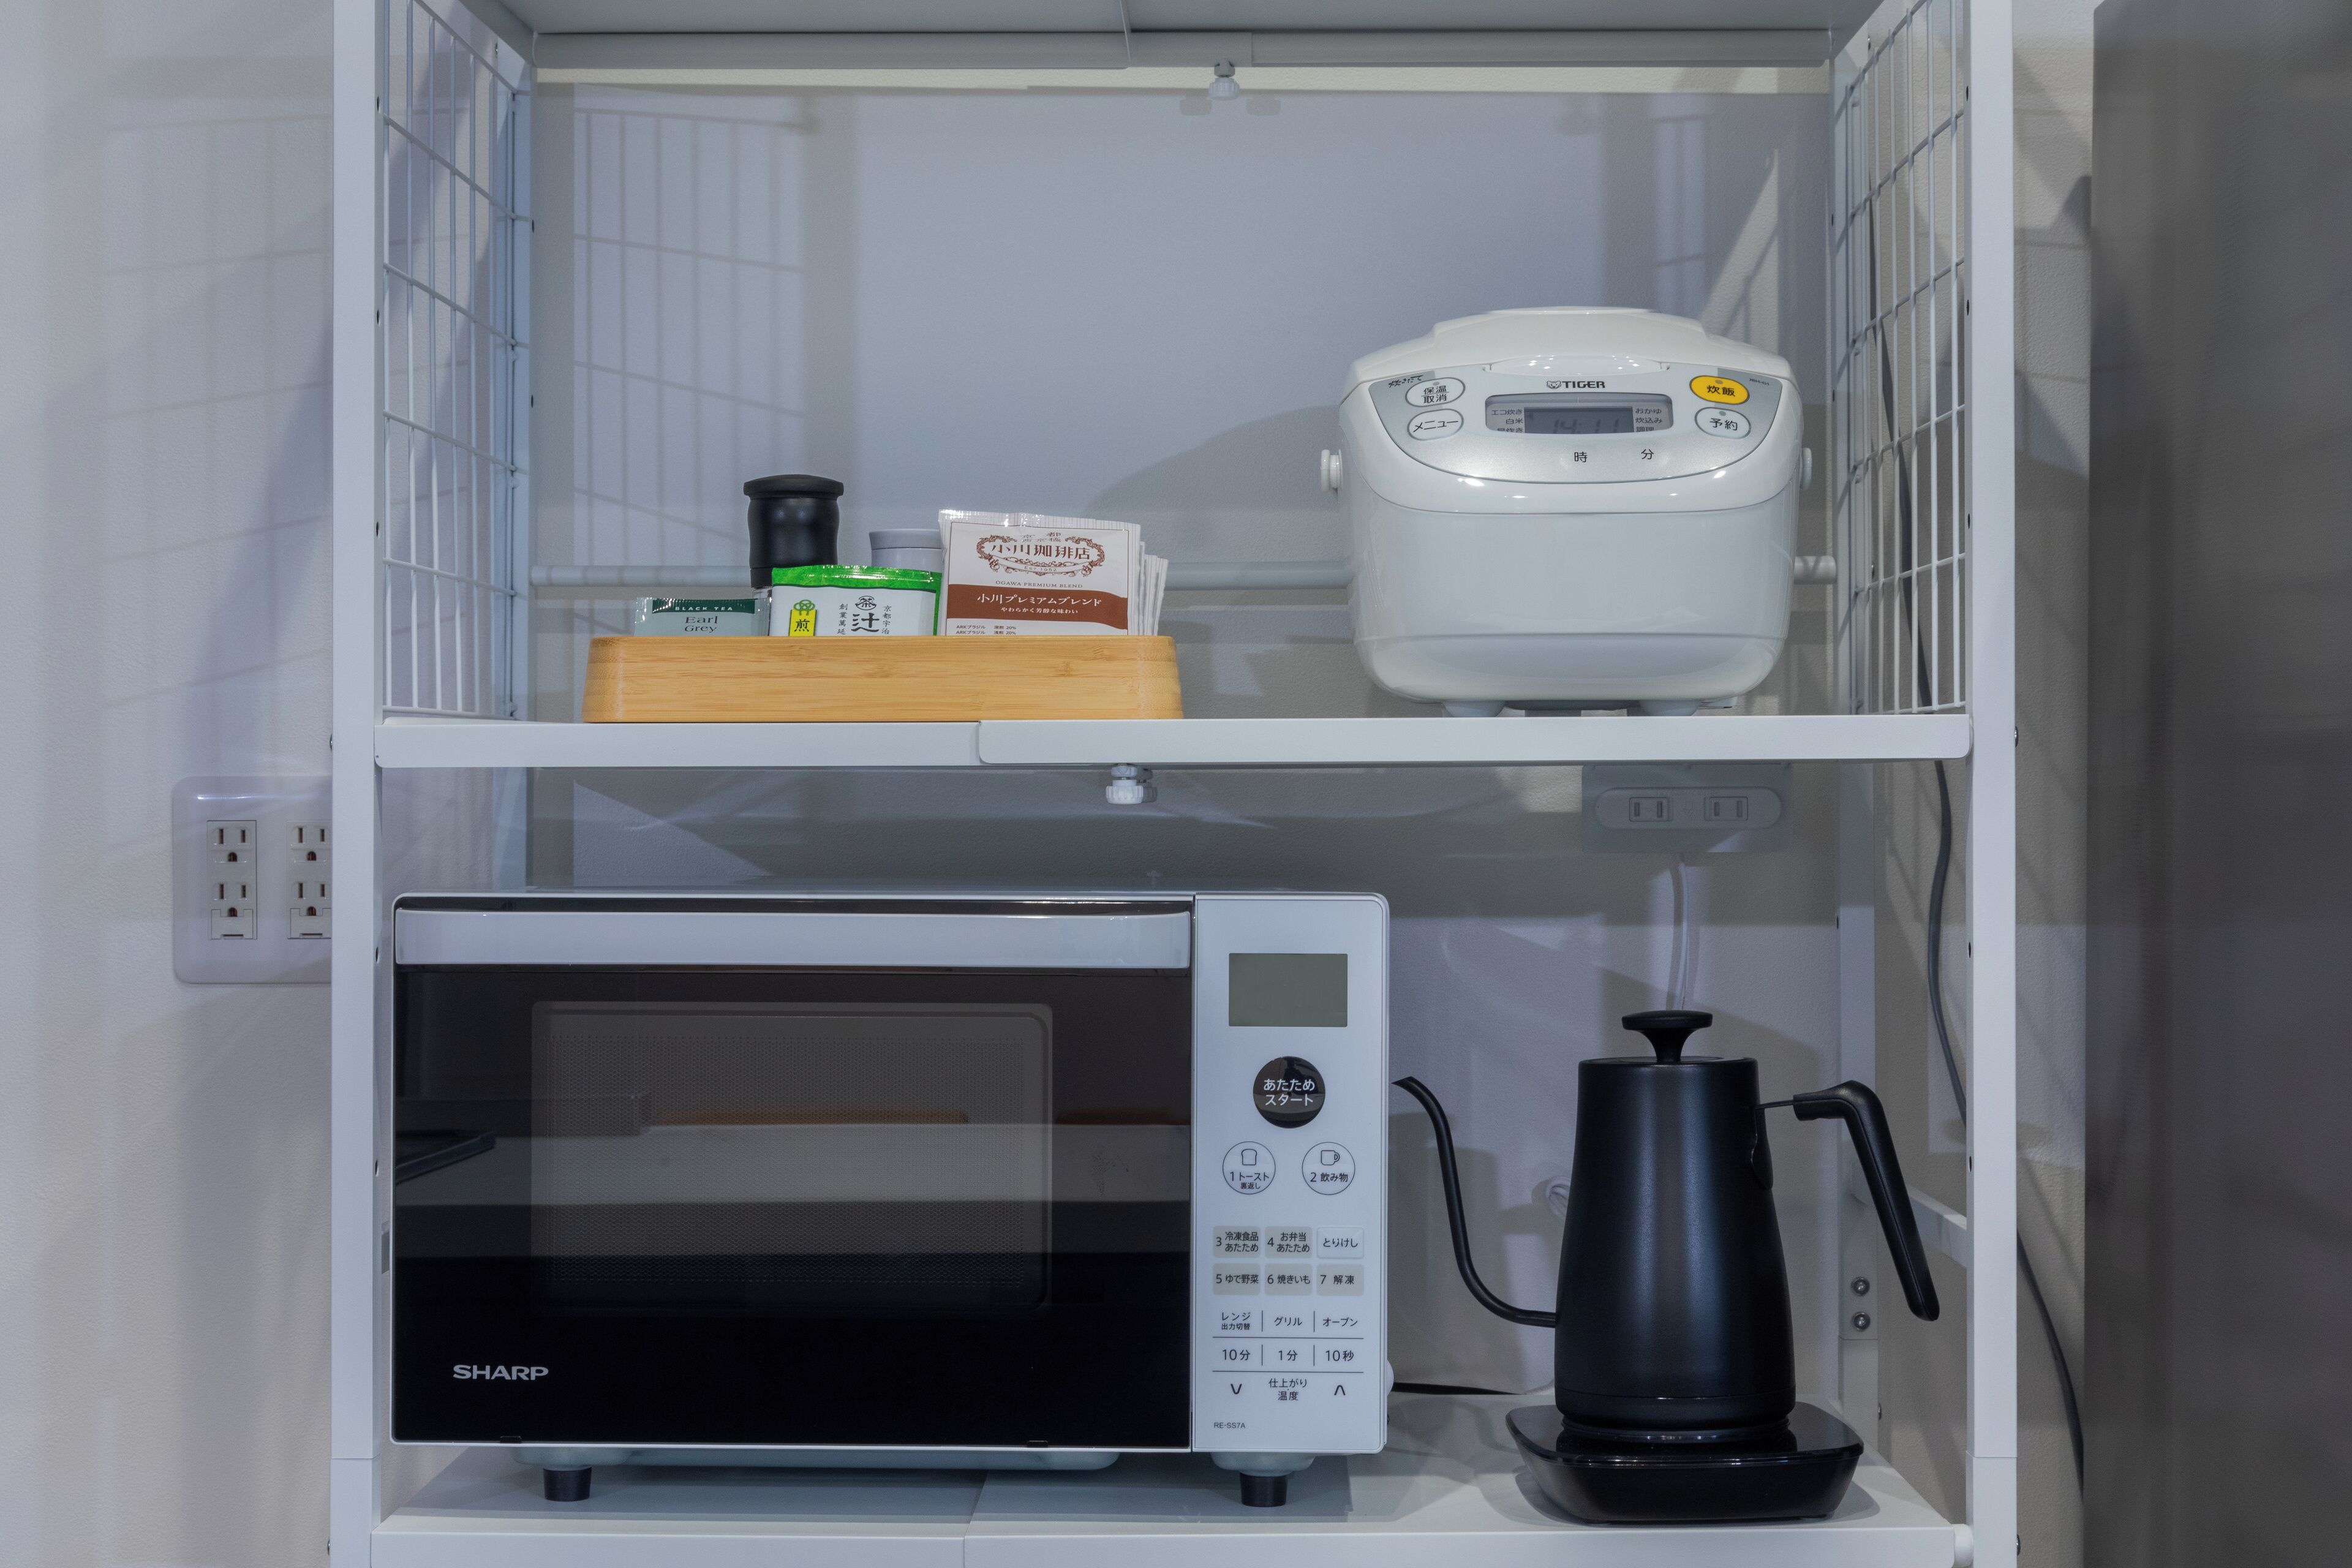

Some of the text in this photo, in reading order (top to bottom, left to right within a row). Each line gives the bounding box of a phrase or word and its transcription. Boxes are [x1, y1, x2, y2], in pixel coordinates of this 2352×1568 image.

[1423, 385, 1447, 394] 保温
[1706, 385, 1735, 397] 炊飯
[1423, 394, 1447, 404] 取消
[1413, 420, 1458, 432] メニュー
[1709, 418, 1738, 431] 予約
[1574, 451, 1587, 462] 時
[1641, 449, 1654, 460] 分
[992, 545, 1090, 560] 小川珈琲店
[977, 594, 1102, 606] 小川プレミアムブレンド
[685, 616, 718, 624] Earl
[851, 612, 880, 632] 辻
[882, 605, 891, 634] 京都宇治
[685, 624, 717, 633] Grey
[793, 619, 810, 633] 煎
[1264, 1079, 1315, 1091] あたため
[1265, 1094, 1314, 1106] スタート
[1239, 1172, 1270, 1181] トースト
[1310, 1172, 1348, 1182] 2 飲み物
[1216, 1237, 1221, 1246] 3
[1225, 1231, 1259, 1242] 冷凍食品
[1267, 1237, 1274, 1246] 4
[1280, 1232, 1306, 1242] お弁当
[1225, 1243, 1259, 1253] あたため
[1276, 1243, 1310, 1253] あたため
[1323, 1238, 1358, 1248] とりけし
[1216, 1275, 1259, 1284] 5 ゆで野菜
[1267, 1275, 1310, 1284] 6 焼きいも
[1320, 1275, 1354, 1284] 7 解凍
[1221, 1312, 1251, 1321] レンジ
[1274, 1317, 1303, 1327] グリル
[1323, 1317, 1358, 1327] オーブン
[1223, 1349, 1250, 1360] 10分
[1278, 1350, 1297, 1361] 1分
[1325, 1350, 1354, 1362] 10秒
[453, 1365, 549, 1380] SHARP
[1269, 1378, 1307, 1388] 仕上がり
[1278, 1391, 1298, 1401] 温度
